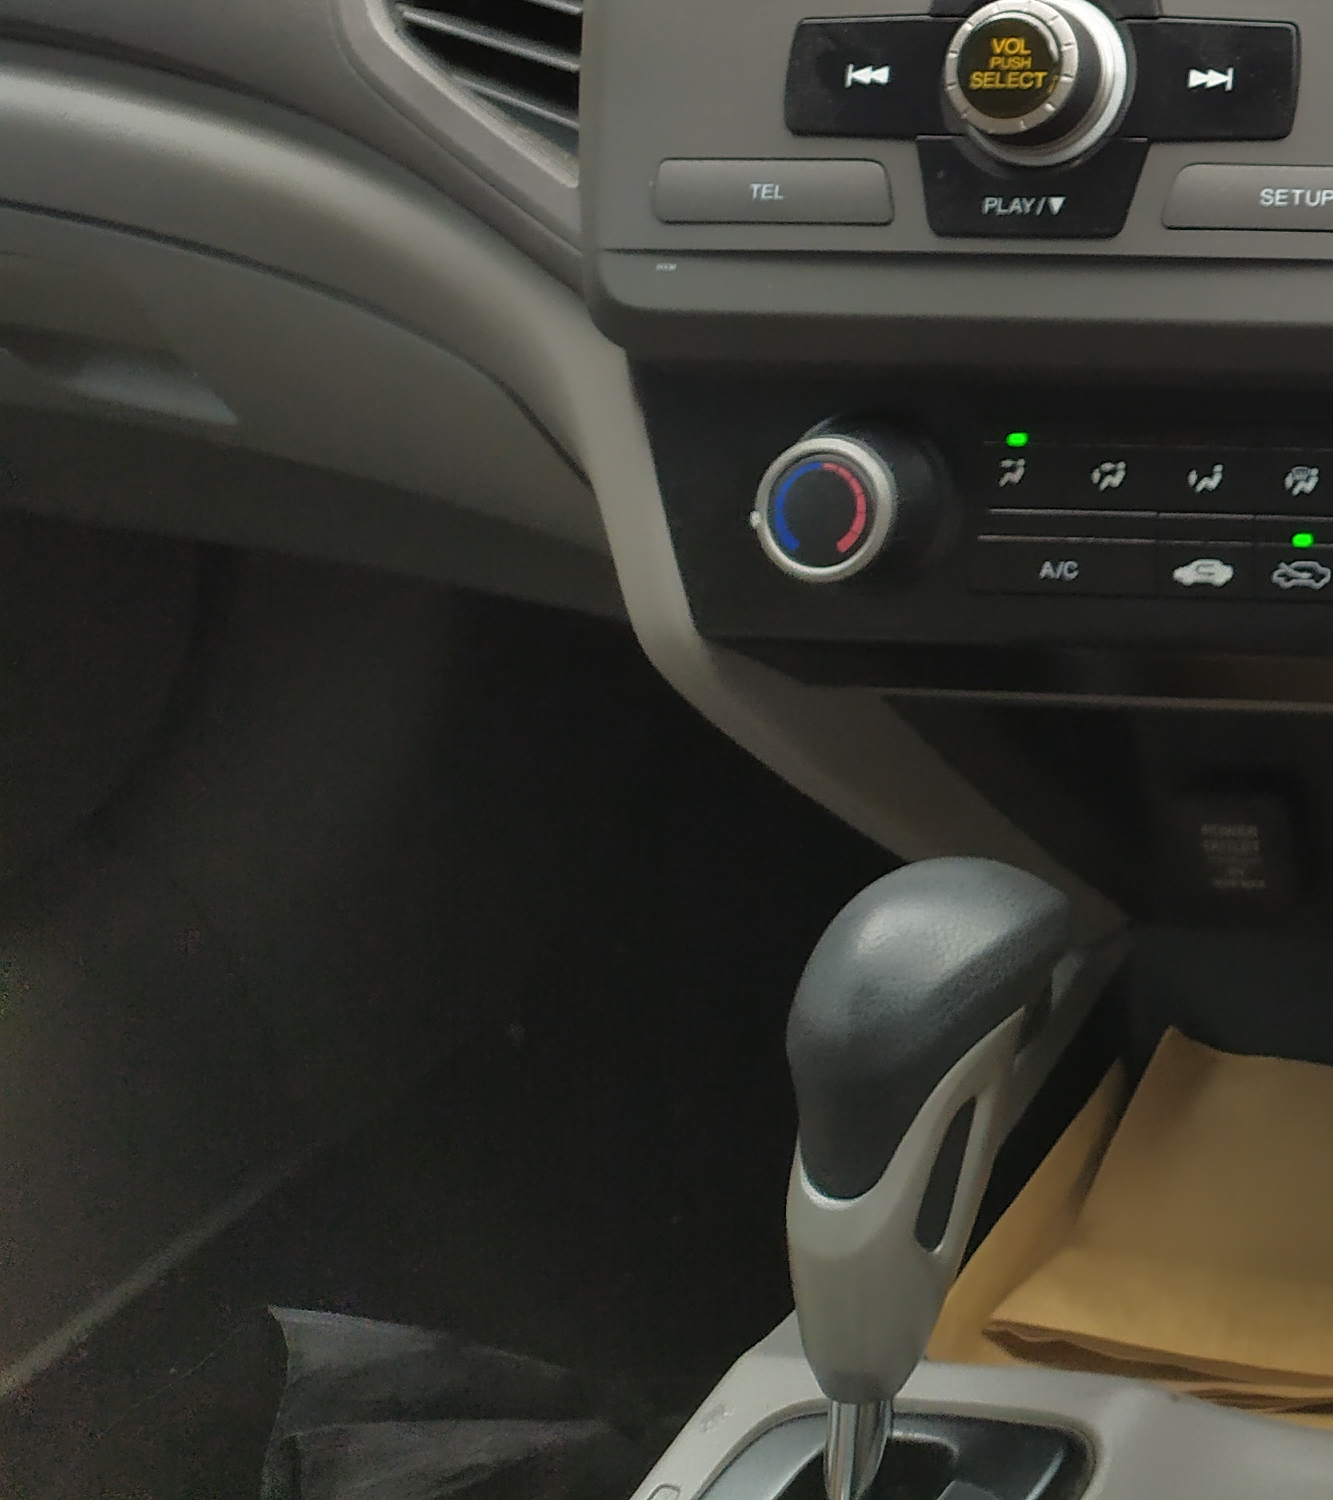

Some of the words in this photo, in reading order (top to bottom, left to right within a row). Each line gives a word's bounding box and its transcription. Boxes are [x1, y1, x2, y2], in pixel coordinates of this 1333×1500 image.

[990, 38, 1032, 55] VOL
[989, 56, 1032, 69] PUSH
[970, 71, 1047, 90] SELECT
[751, 183, 784, 201] TEL
[1039, 560, 1080, 581] A/C
